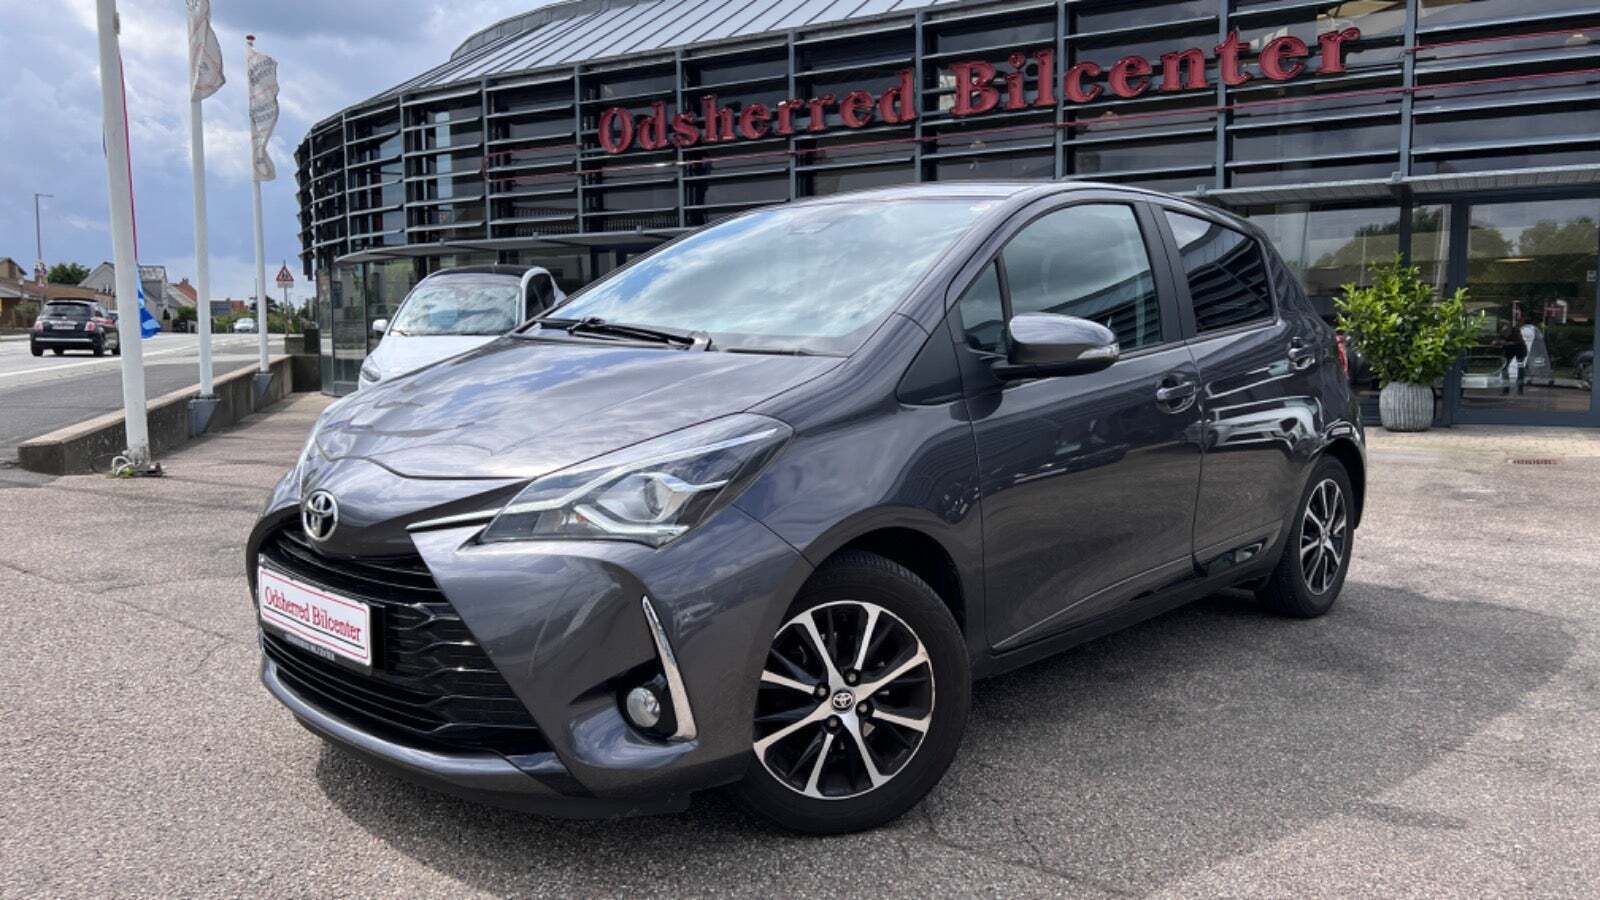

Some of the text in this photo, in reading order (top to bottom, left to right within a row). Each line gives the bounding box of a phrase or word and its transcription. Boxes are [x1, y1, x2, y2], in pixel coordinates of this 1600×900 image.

[598, 26, 1361, 154] Odsherred Bilcenter
[264, 586, 361, 641] Odsherred Bilcenter
